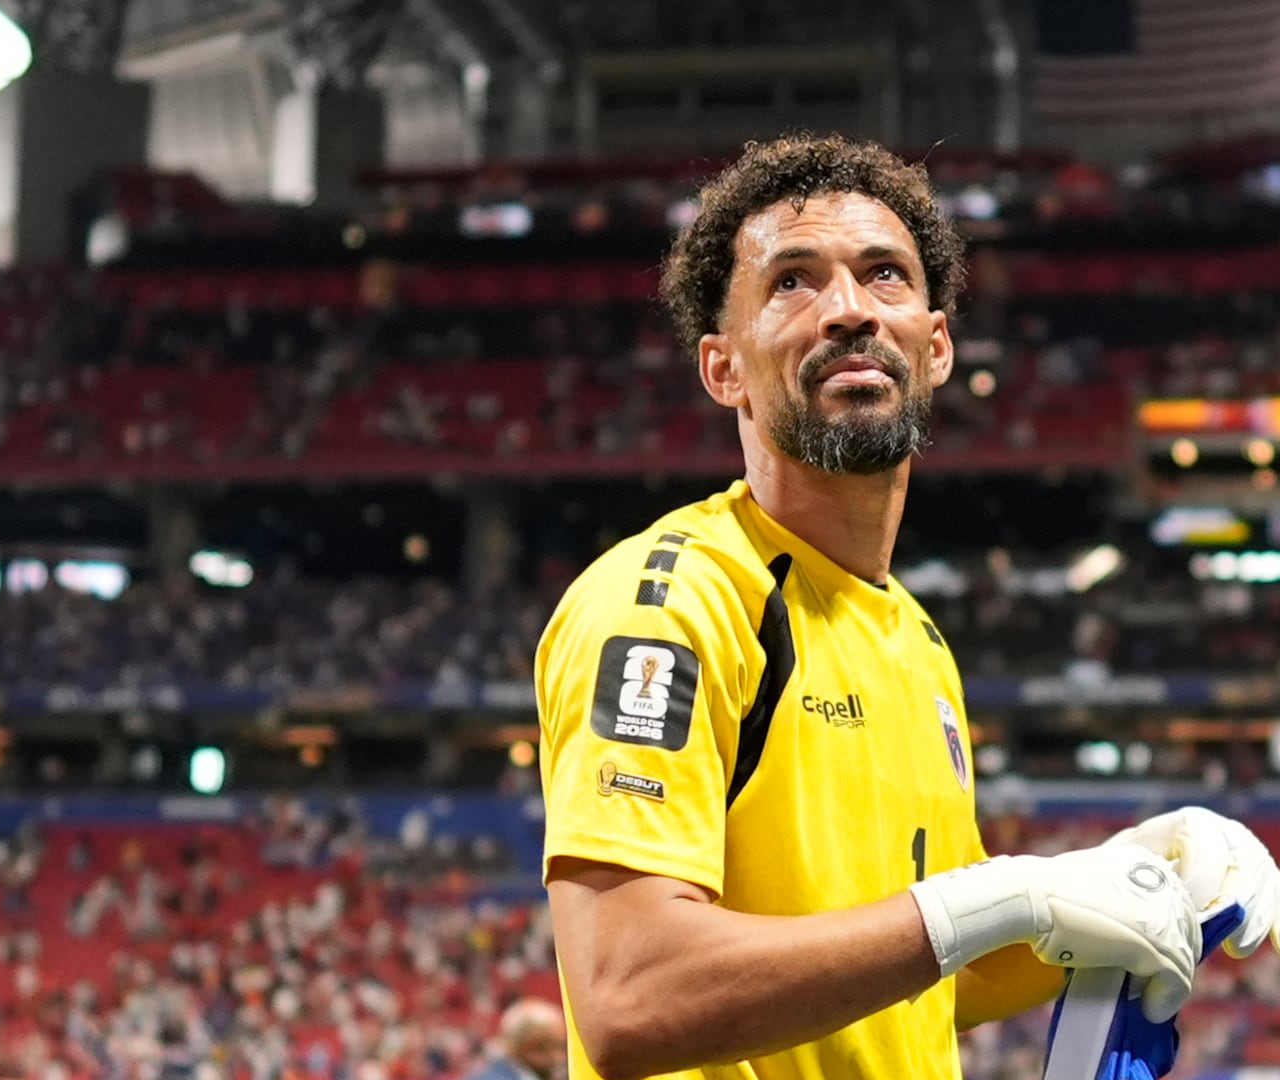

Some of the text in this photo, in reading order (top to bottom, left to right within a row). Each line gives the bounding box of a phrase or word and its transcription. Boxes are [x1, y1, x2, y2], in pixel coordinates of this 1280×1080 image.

[633, 700, 654, 711] FIFA
[616, 714, 665, 729] WORLD CUP
[614, 722, 663, 740] 2026
[615, 774, 661, 791] DEBUT
[912, 827, 926, 882] 1
